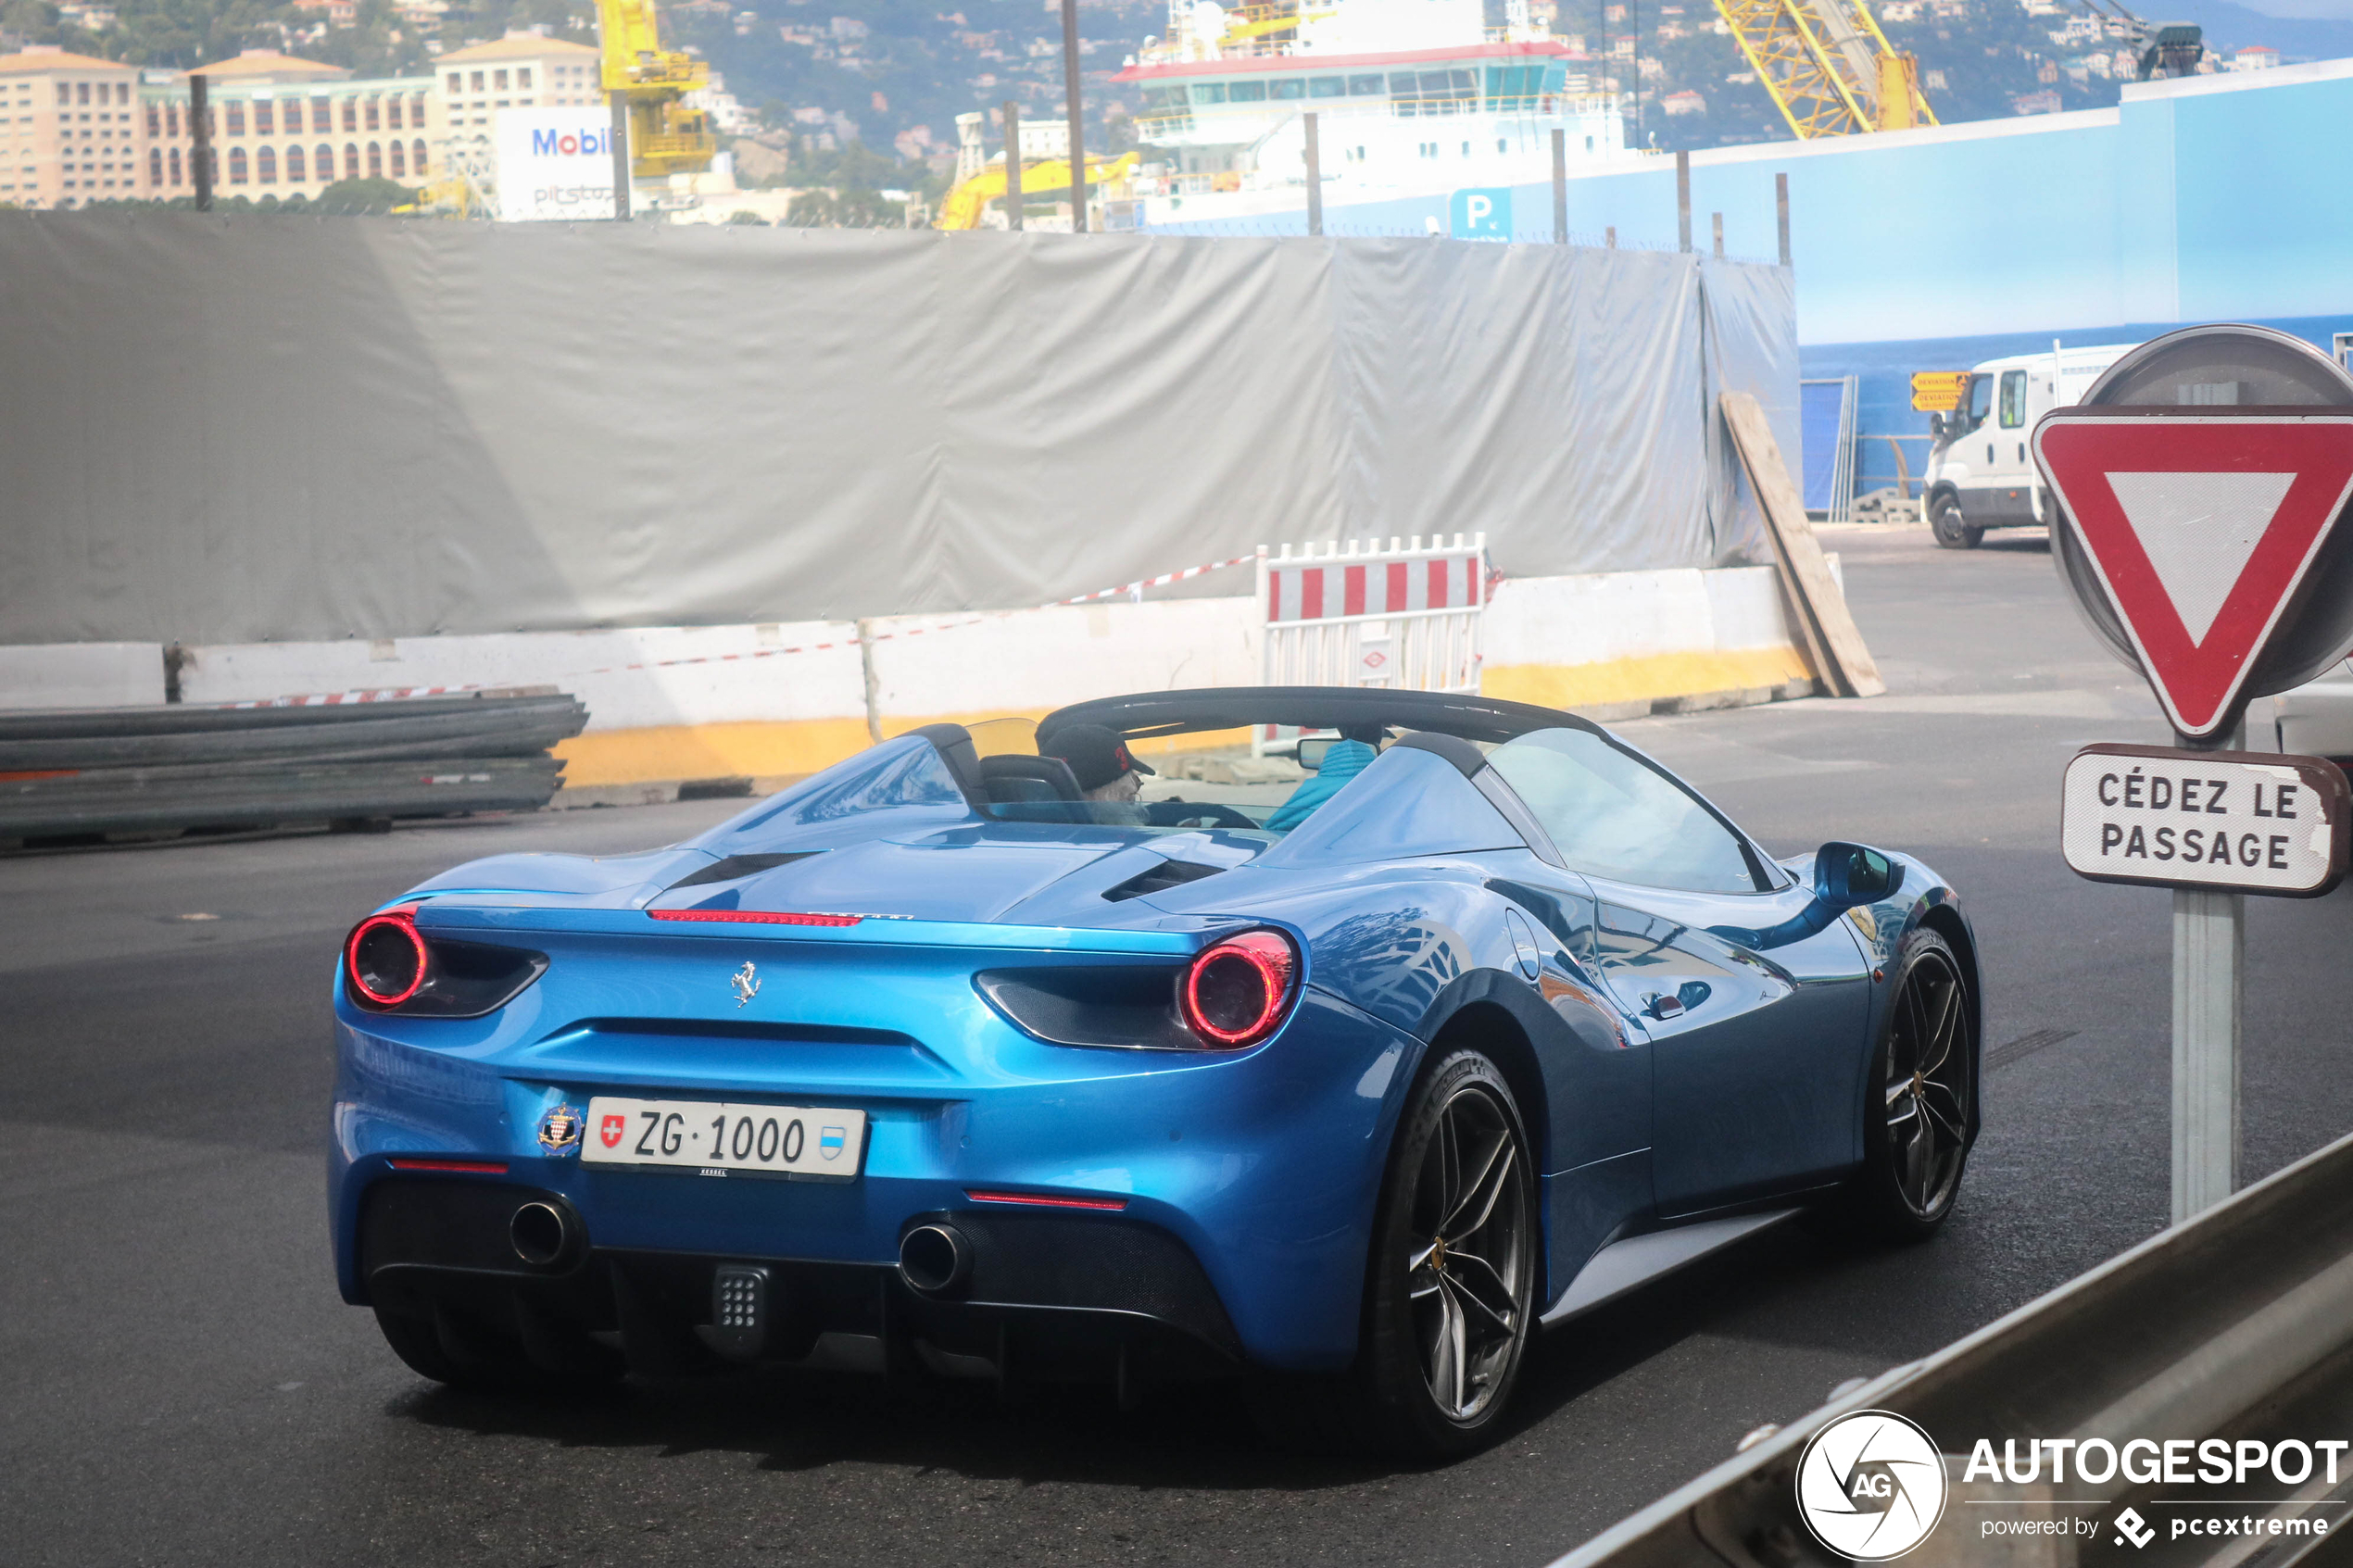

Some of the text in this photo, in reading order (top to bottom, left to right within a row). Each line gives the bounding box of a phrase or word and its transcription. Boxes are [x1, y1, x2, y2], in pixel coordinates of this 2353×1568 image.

[533, 128, 613, 156] Mobil
[1466, 194, 1492, 229] P
[2098, 767, 2298, 819] CÉDEZ LE
[2101, 823, 2289, 869] PASSAGE
